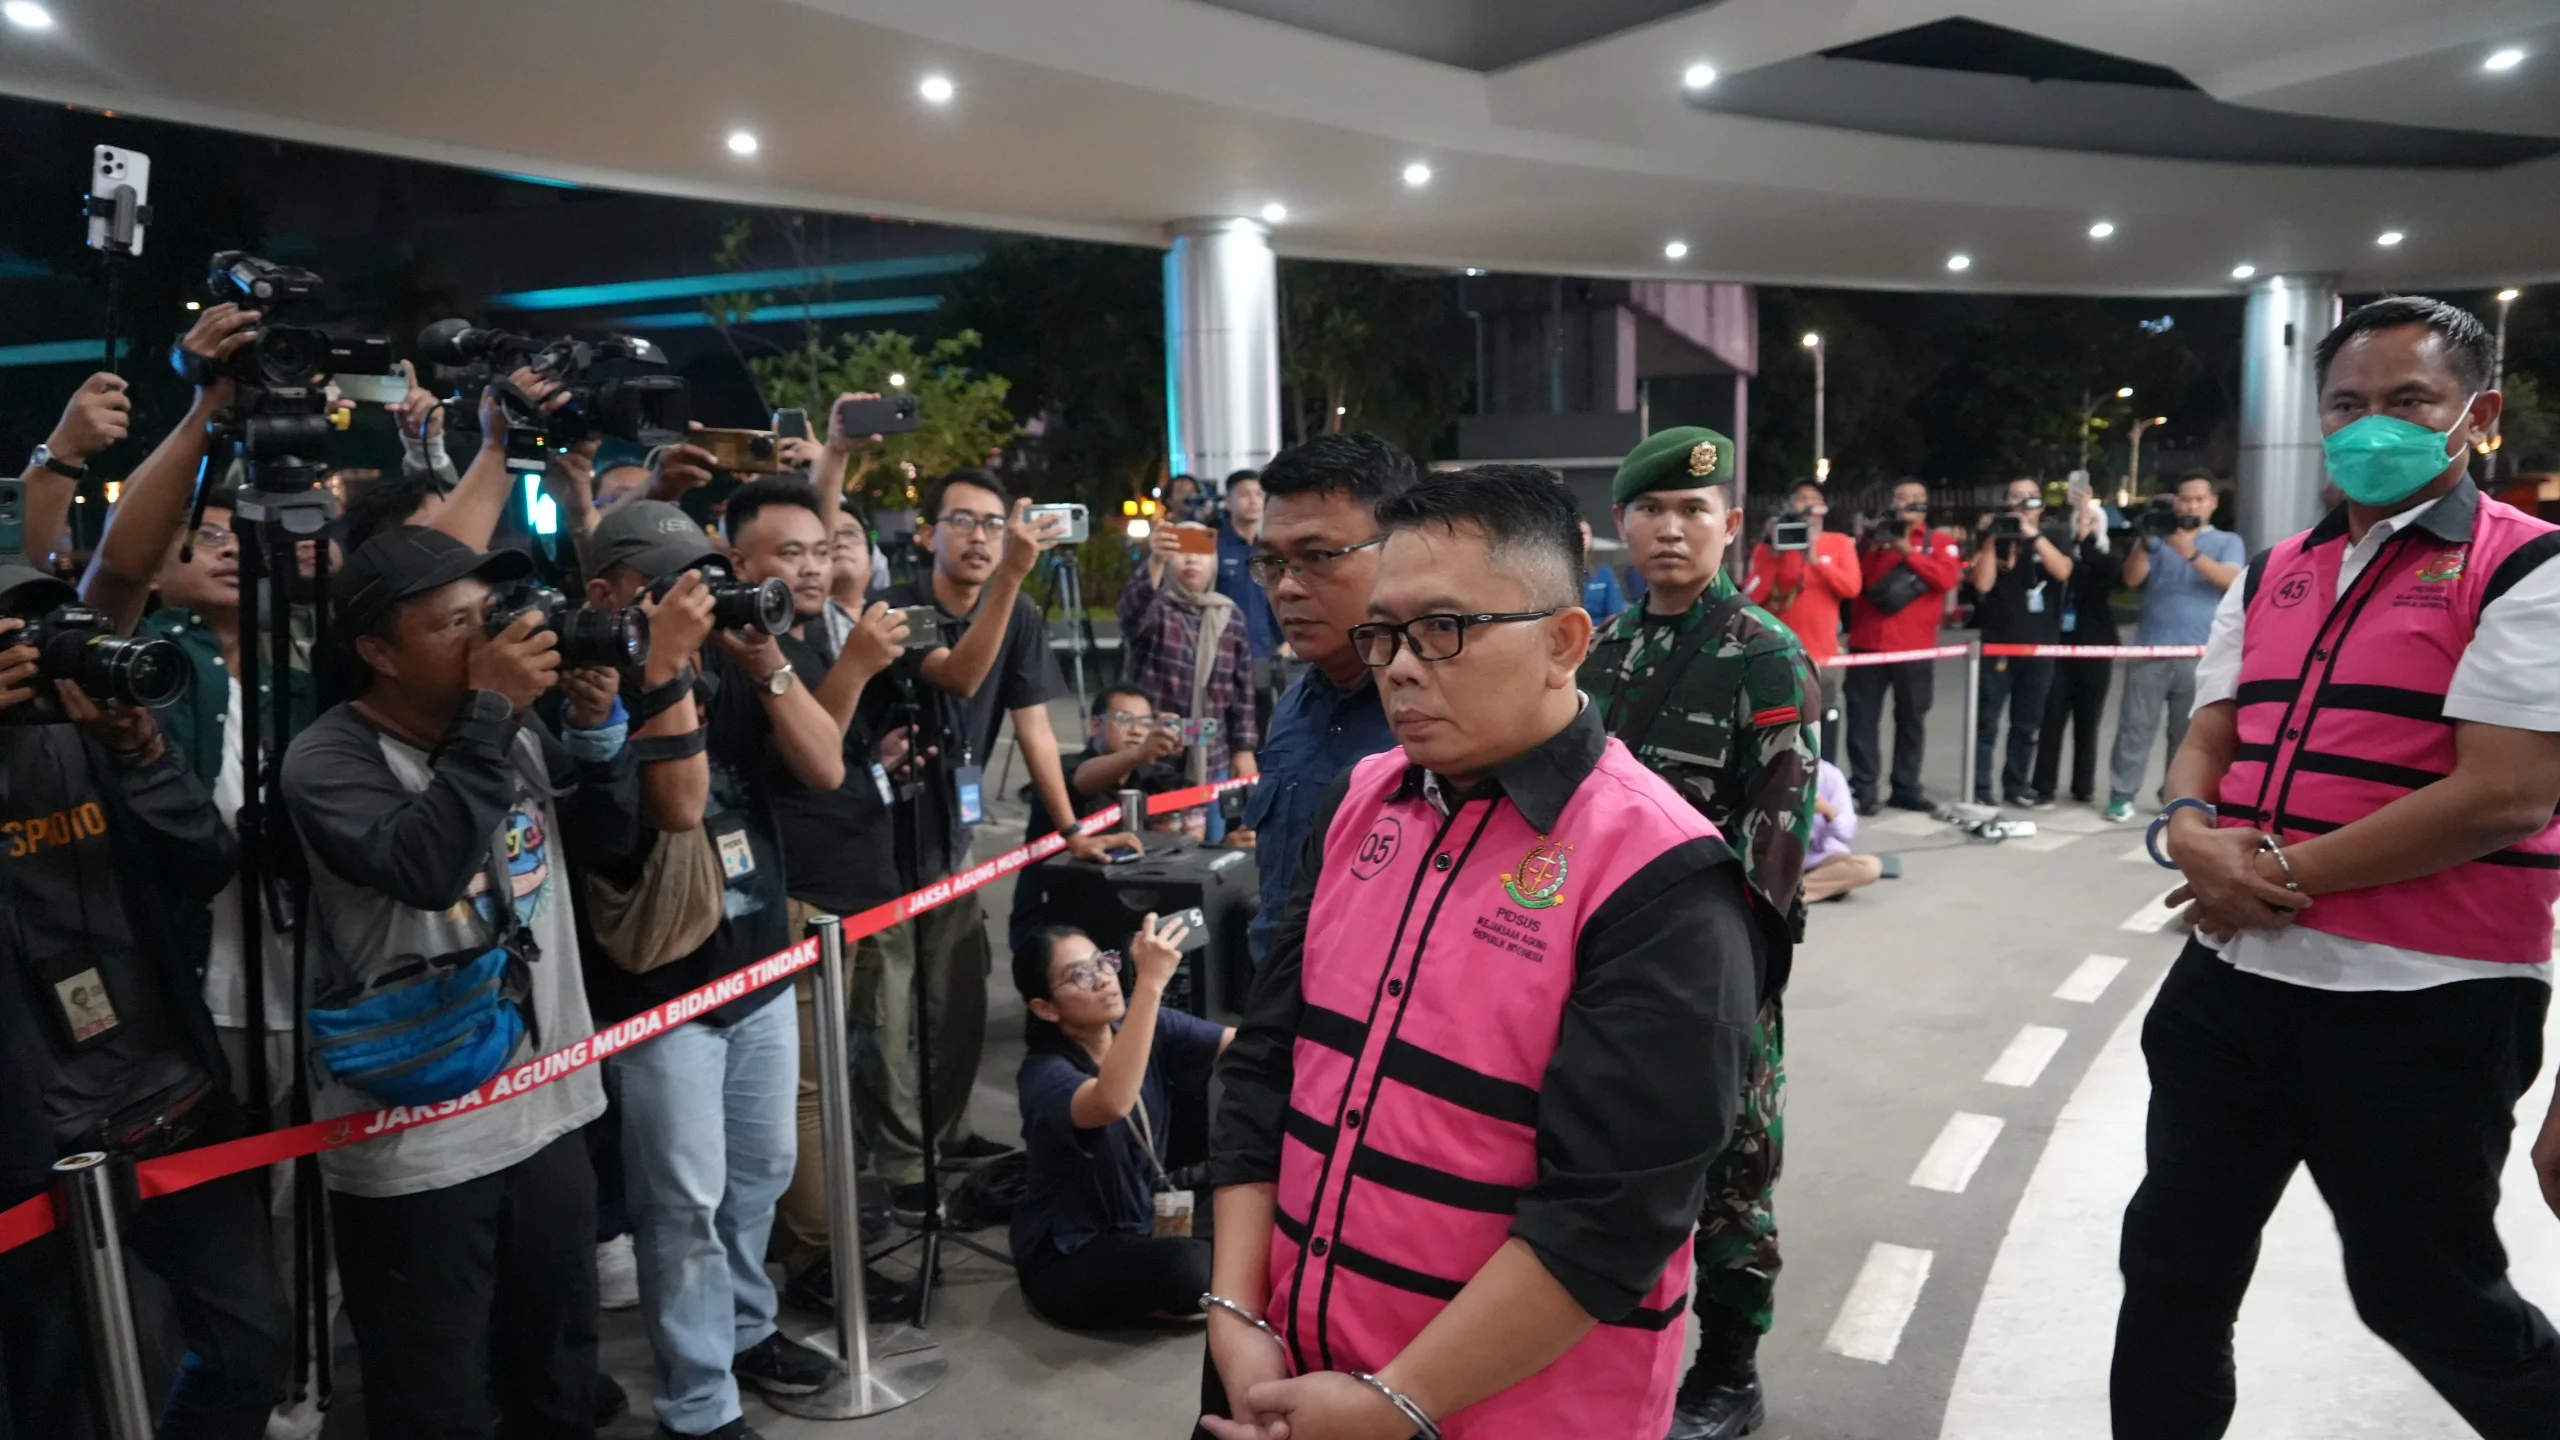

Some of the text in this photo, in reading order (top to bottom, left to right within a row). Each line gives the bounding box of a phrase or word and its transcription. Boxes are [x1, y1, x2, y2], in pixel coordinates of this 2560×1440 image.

[2279, 579, 2309, 600] 45
[1359, 833, 1396, 864] 05
[908, 882, 951, 913] JAKSA
[953, 861, 996, 893] AGUNG
[1496, 907, 1541, 932] PIDSUS
[364, 938, 819, 1134] JAKSA AGUNG MUDA BIDANG TINDAK
